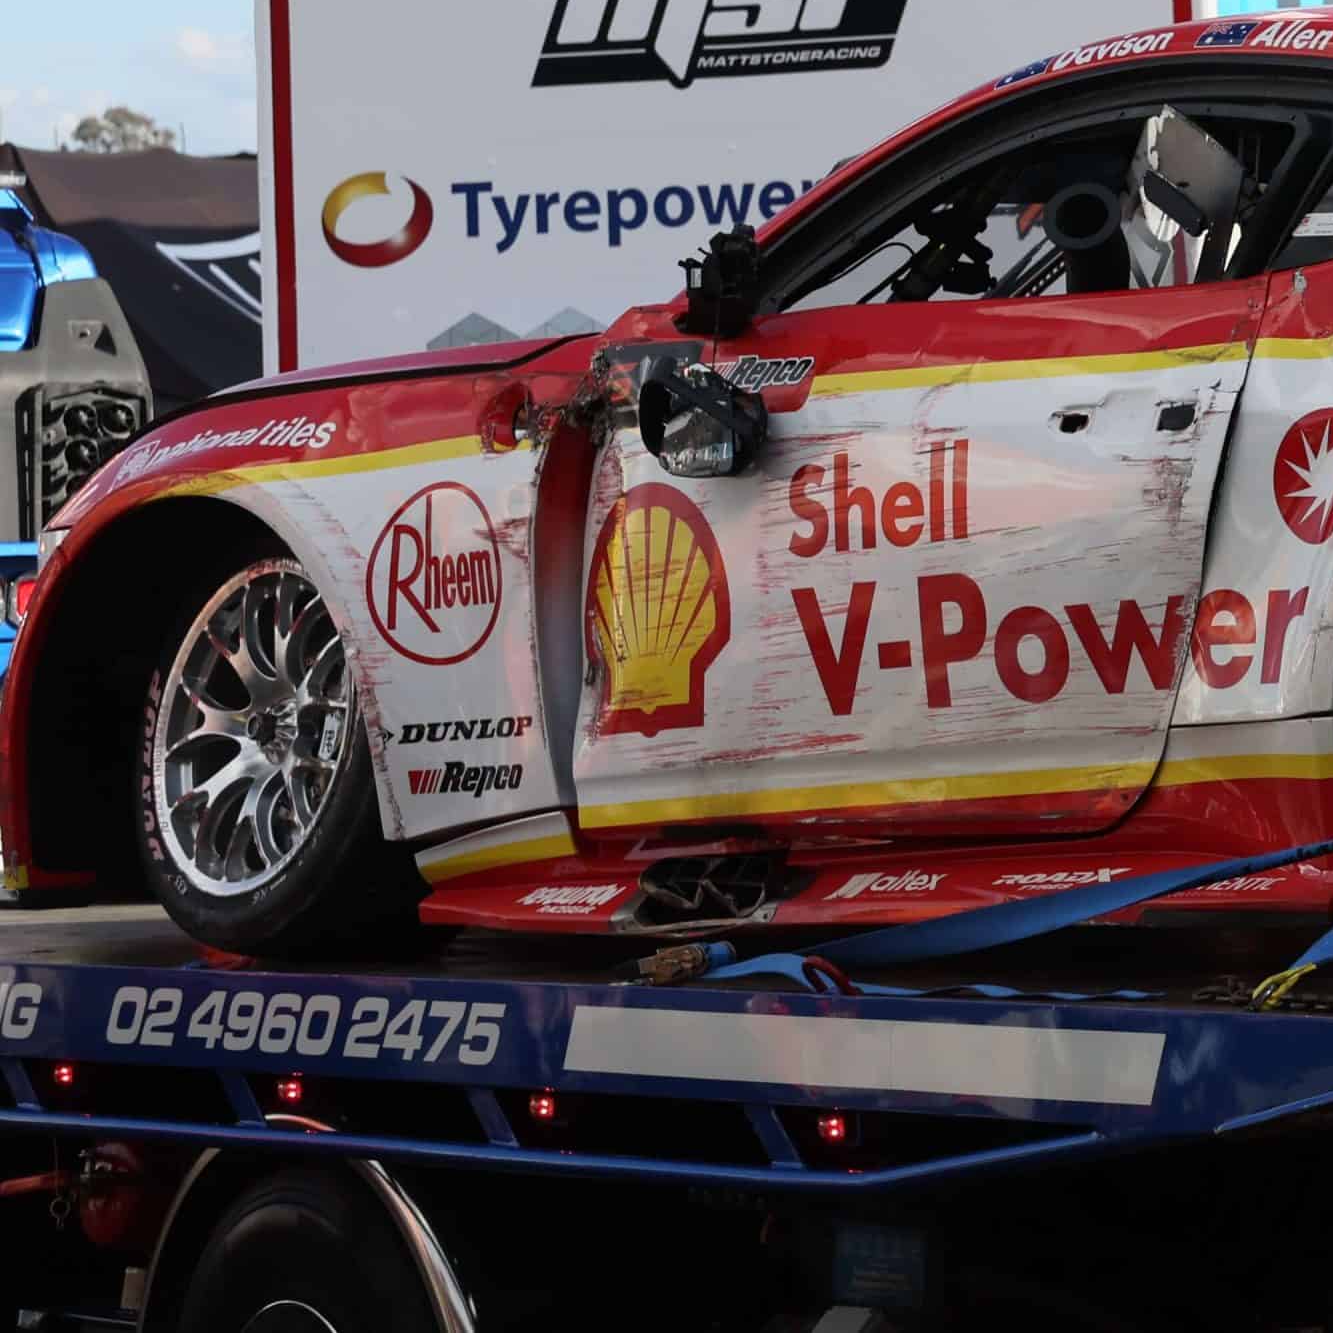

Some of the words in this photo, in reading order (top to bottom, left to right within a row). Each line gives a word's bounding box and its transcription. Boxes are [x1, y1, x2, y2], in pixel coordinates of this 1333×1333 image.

[697, 45, 882, 69] MATTSTONERACING
[1052, 32, 1175, 70] Davison
[728, 354, 815, 394] Repco
[152, 428, 263, 464] national
[259, 417, 337, 448] tiles
[787, 438, 970, 559] Shell
[387, 493, 496, 634] Rheem
[791, 572, 1310, 717] V-Power
[397, 715, 533, 745] DUNLOP
[440, 761, 524, 798] Repco
[106, 985, 184, 1047] 02
[187, 991, 341, 1056] 4960
[342, 996, 507, 1066] 2475
